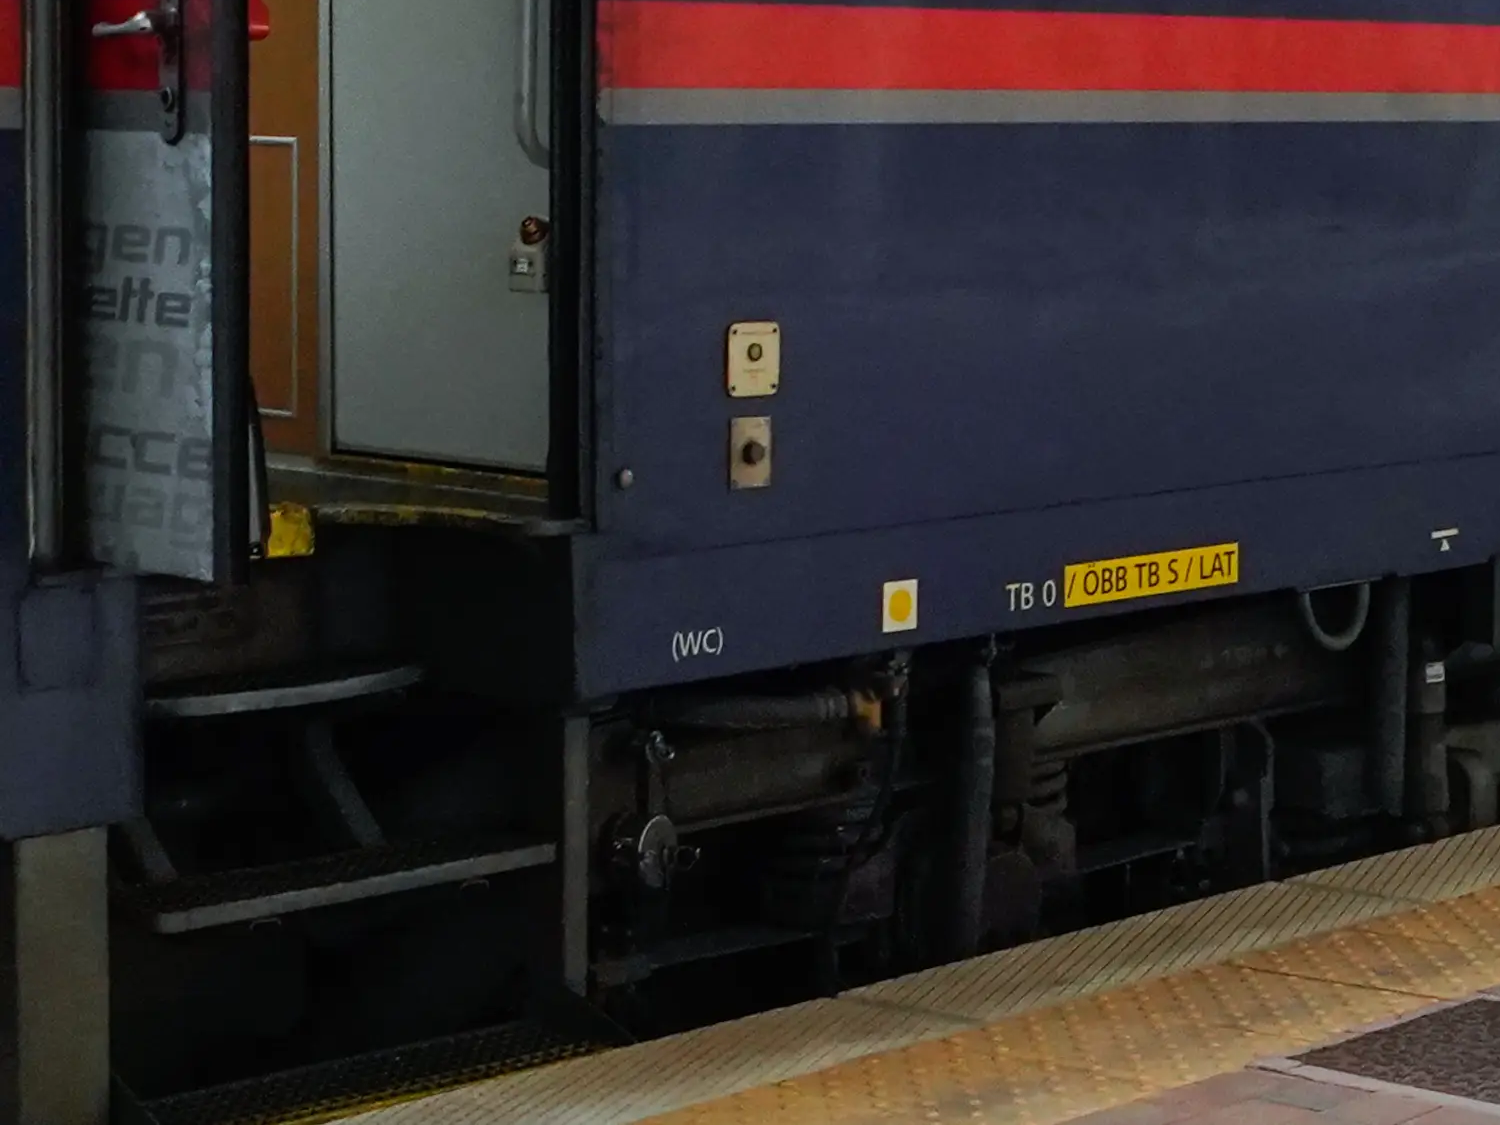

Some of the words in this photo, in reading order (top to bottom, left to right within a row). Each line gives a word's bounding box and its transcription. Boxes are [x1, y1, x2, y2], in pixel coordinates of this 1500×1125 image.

[1005, 581, 1035, 611] TB
[1067, 570, 1077, 599] /
[1083, 563, 1128, 596] ÖBB
[1135, 561, 1161, 589] TB
[1167, 558, 1179, 585] S
[1184, 556, 1194, 583] /
[1200, 550, 1236, 581] LAT
[671, 626, 724, 663] (WC)
